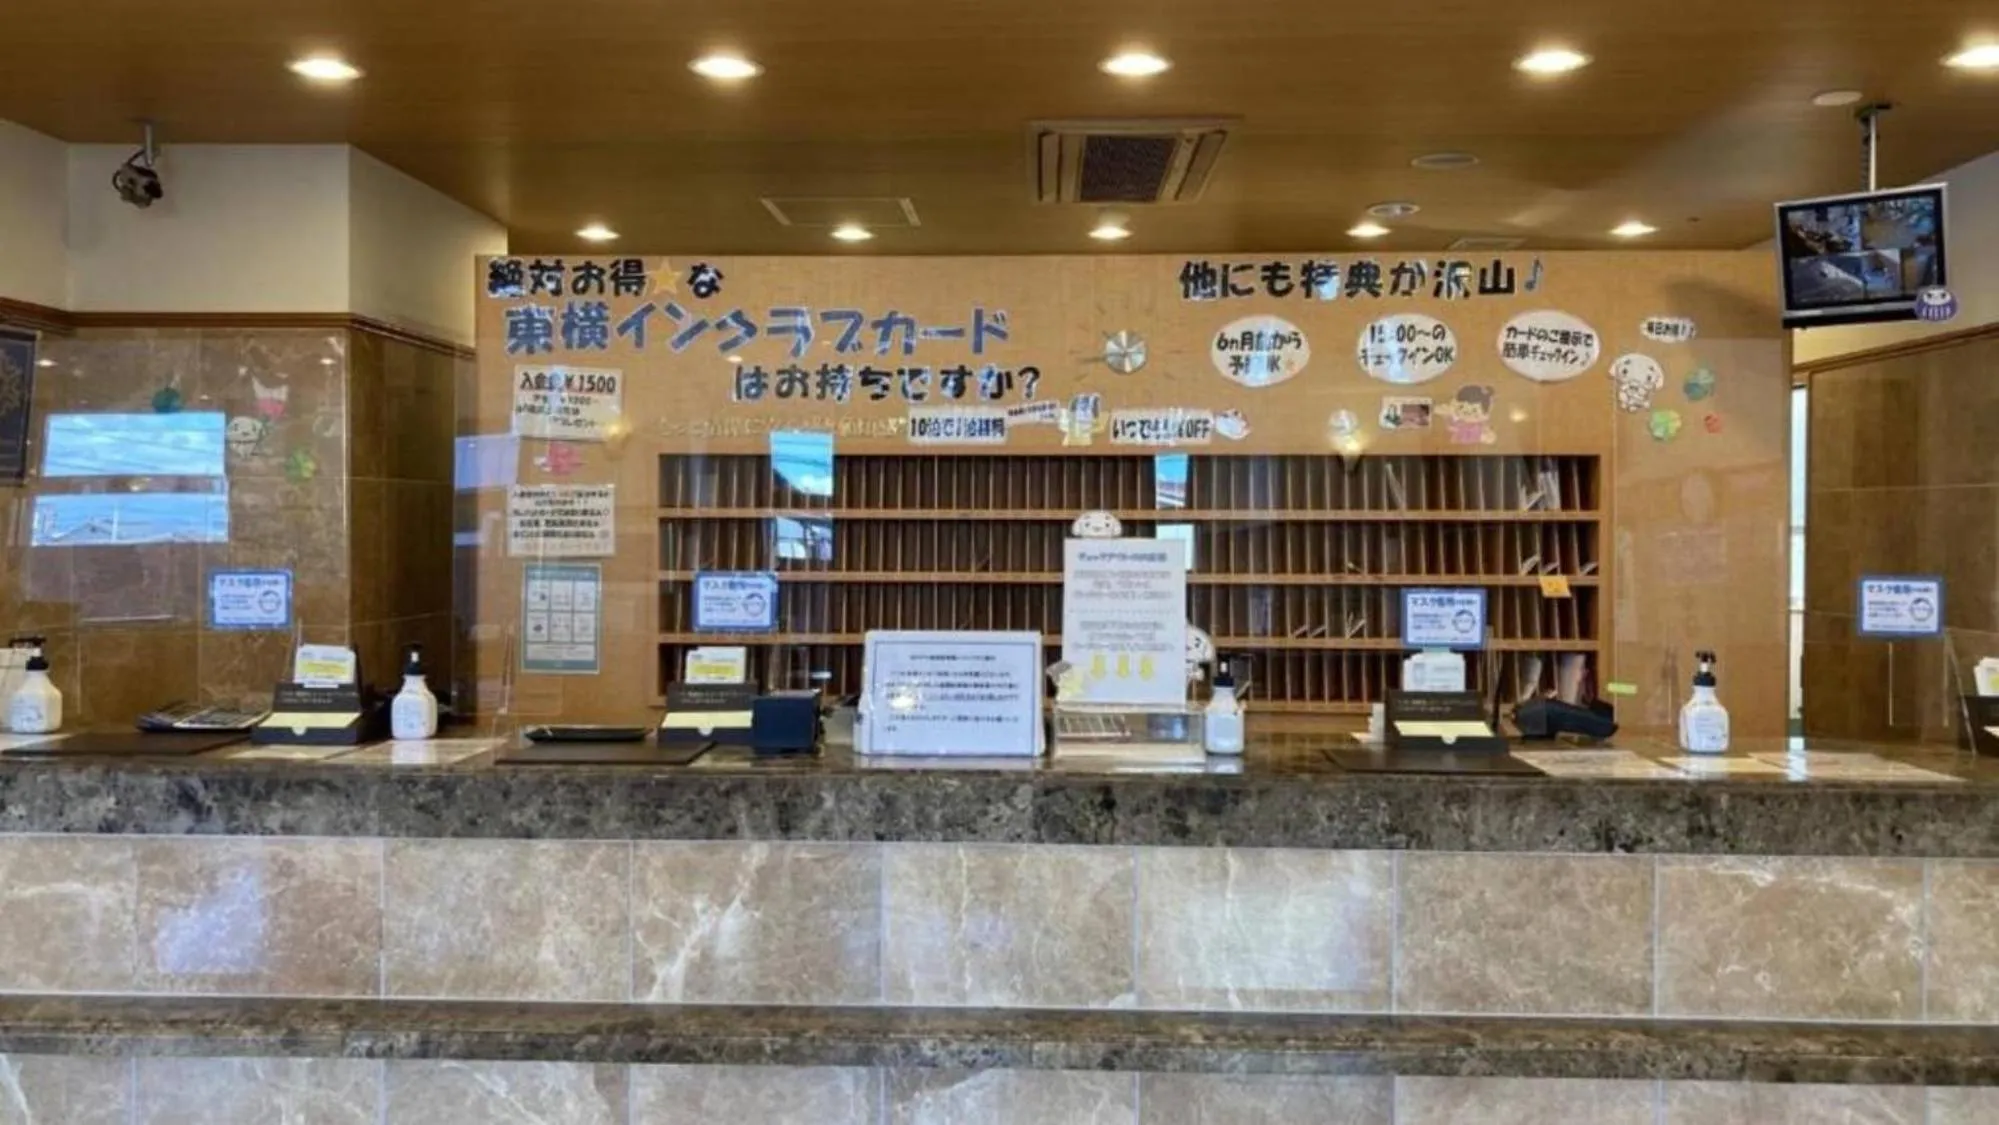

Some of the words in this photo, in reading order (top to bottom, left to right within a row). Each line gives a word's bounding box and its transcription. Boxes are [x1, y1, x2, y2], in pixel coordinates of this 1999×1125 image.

[505, 301, 1010, 356] 東横インクラブカード
